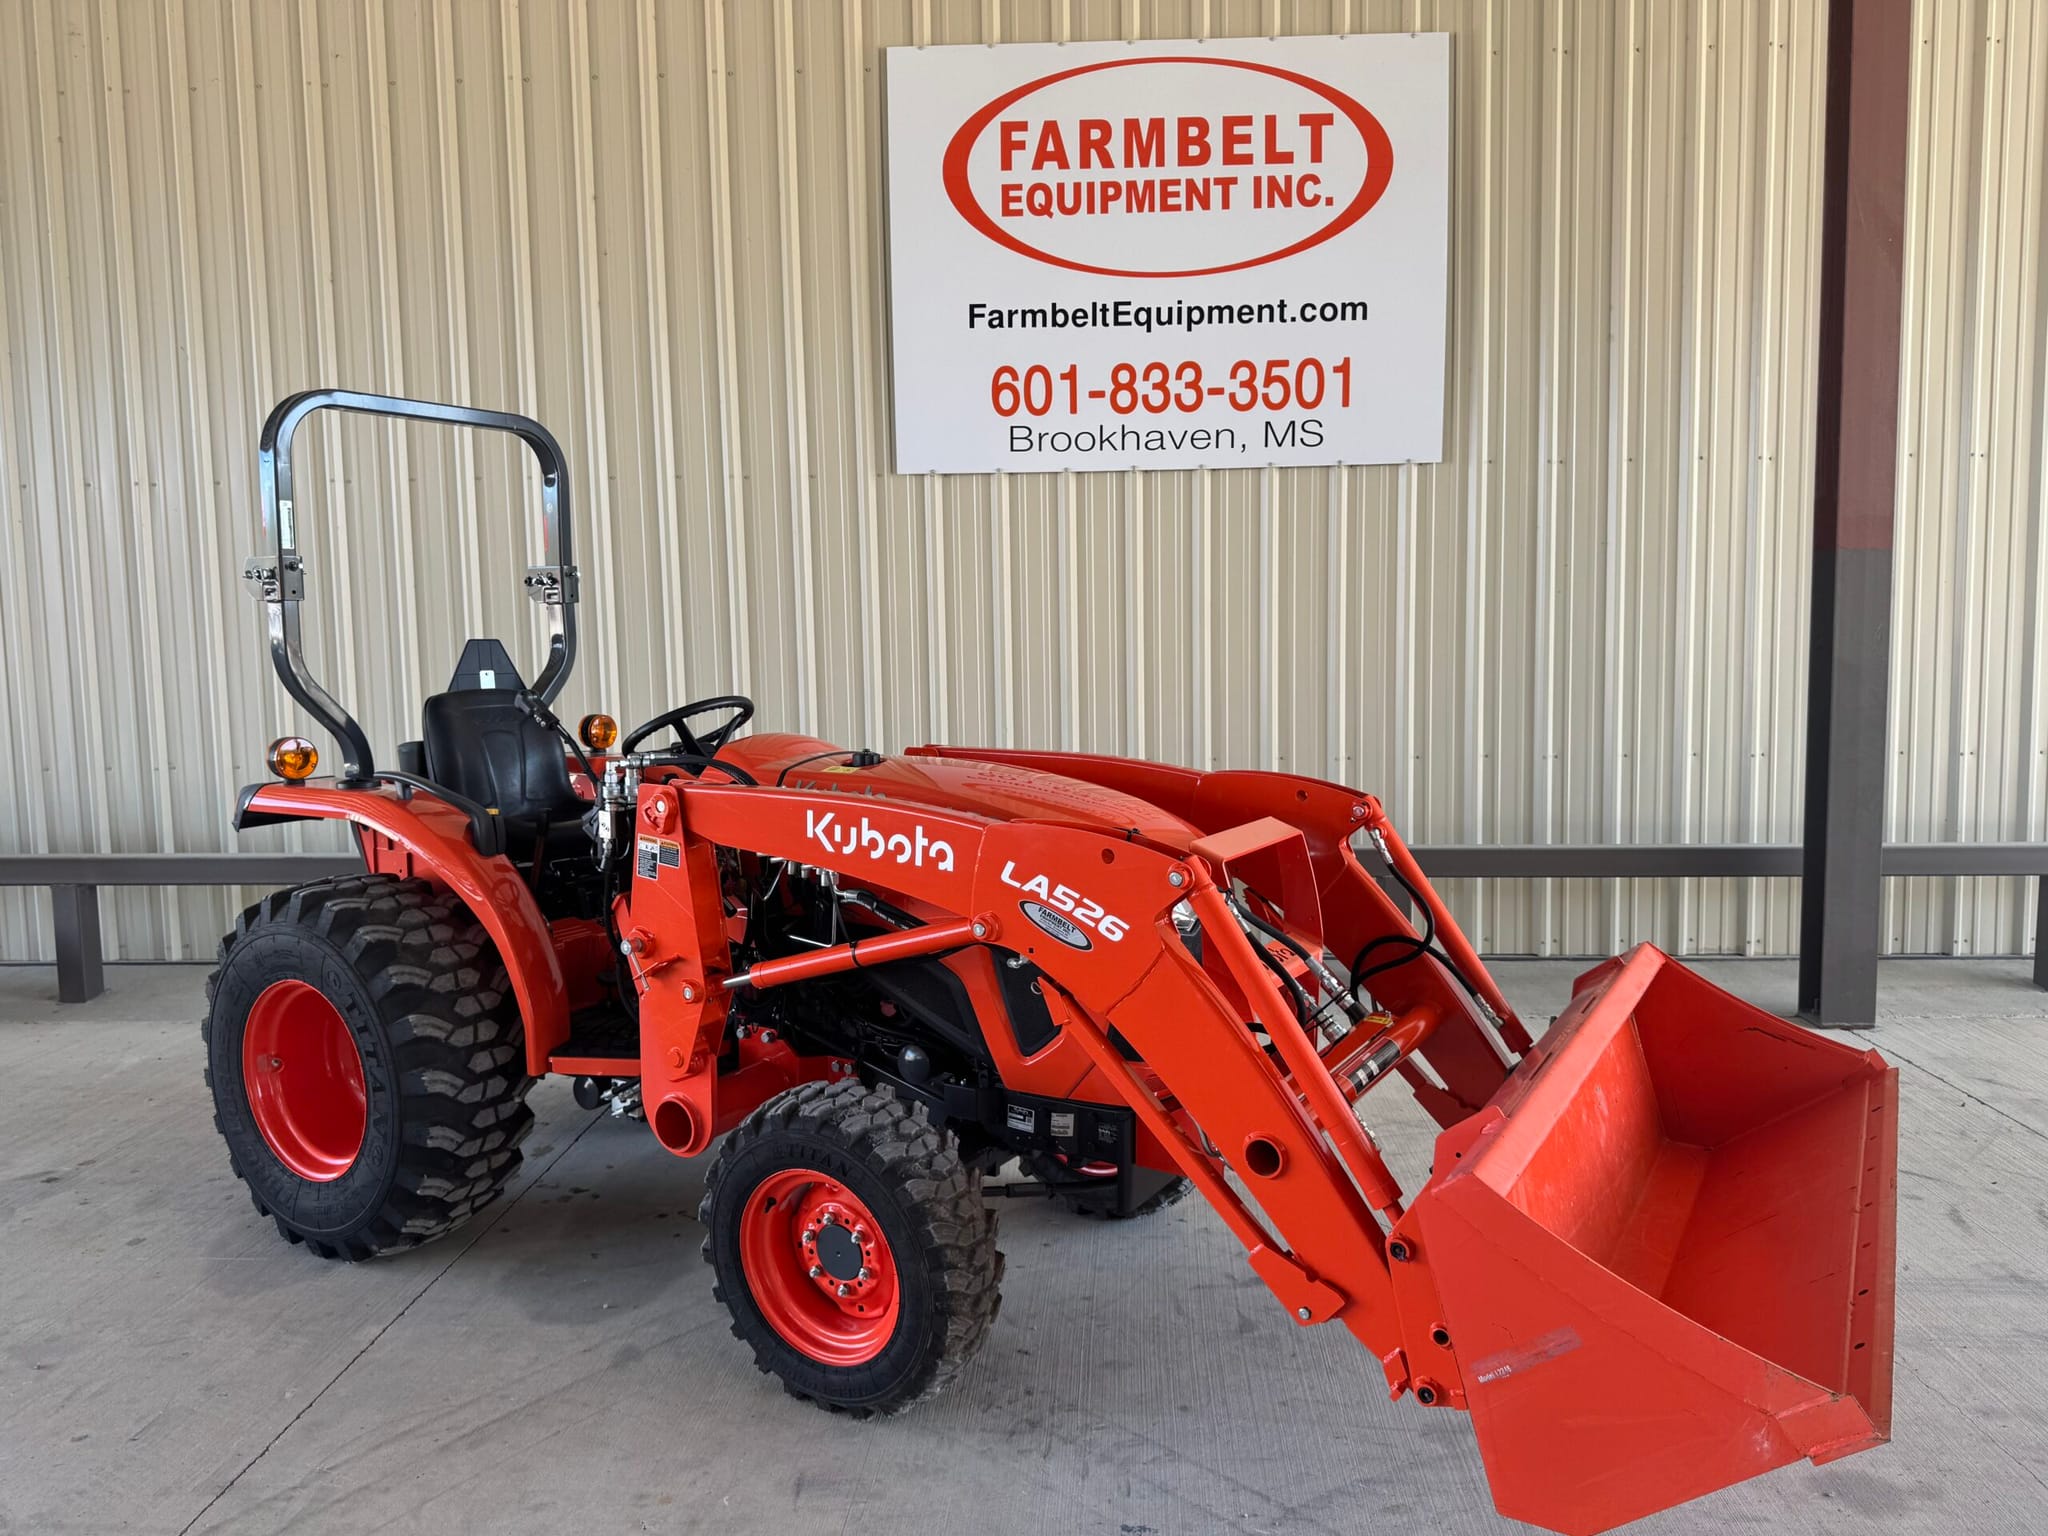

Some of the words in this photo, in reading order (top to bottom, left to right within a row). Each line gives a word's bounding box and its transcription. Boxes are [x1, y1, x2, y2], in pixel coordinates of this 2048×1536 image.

[999, 113, 1334, 171] FARMBELT
[1002, 177, 1237, 218] EQUIPMENT
[1253, 174, 1334, 208] INC.
[968, 300, 1367, 332] FarmbeltEquipment.com
[991, 357, 1351, 417] 601-833-3501
[1010, 424, 1246, 453] Brookhaven,
[1264, 420, 1324, 447] MS
[807, 809, 955, 872] Kubota
[1001, 861, 1130, 942] LA526
